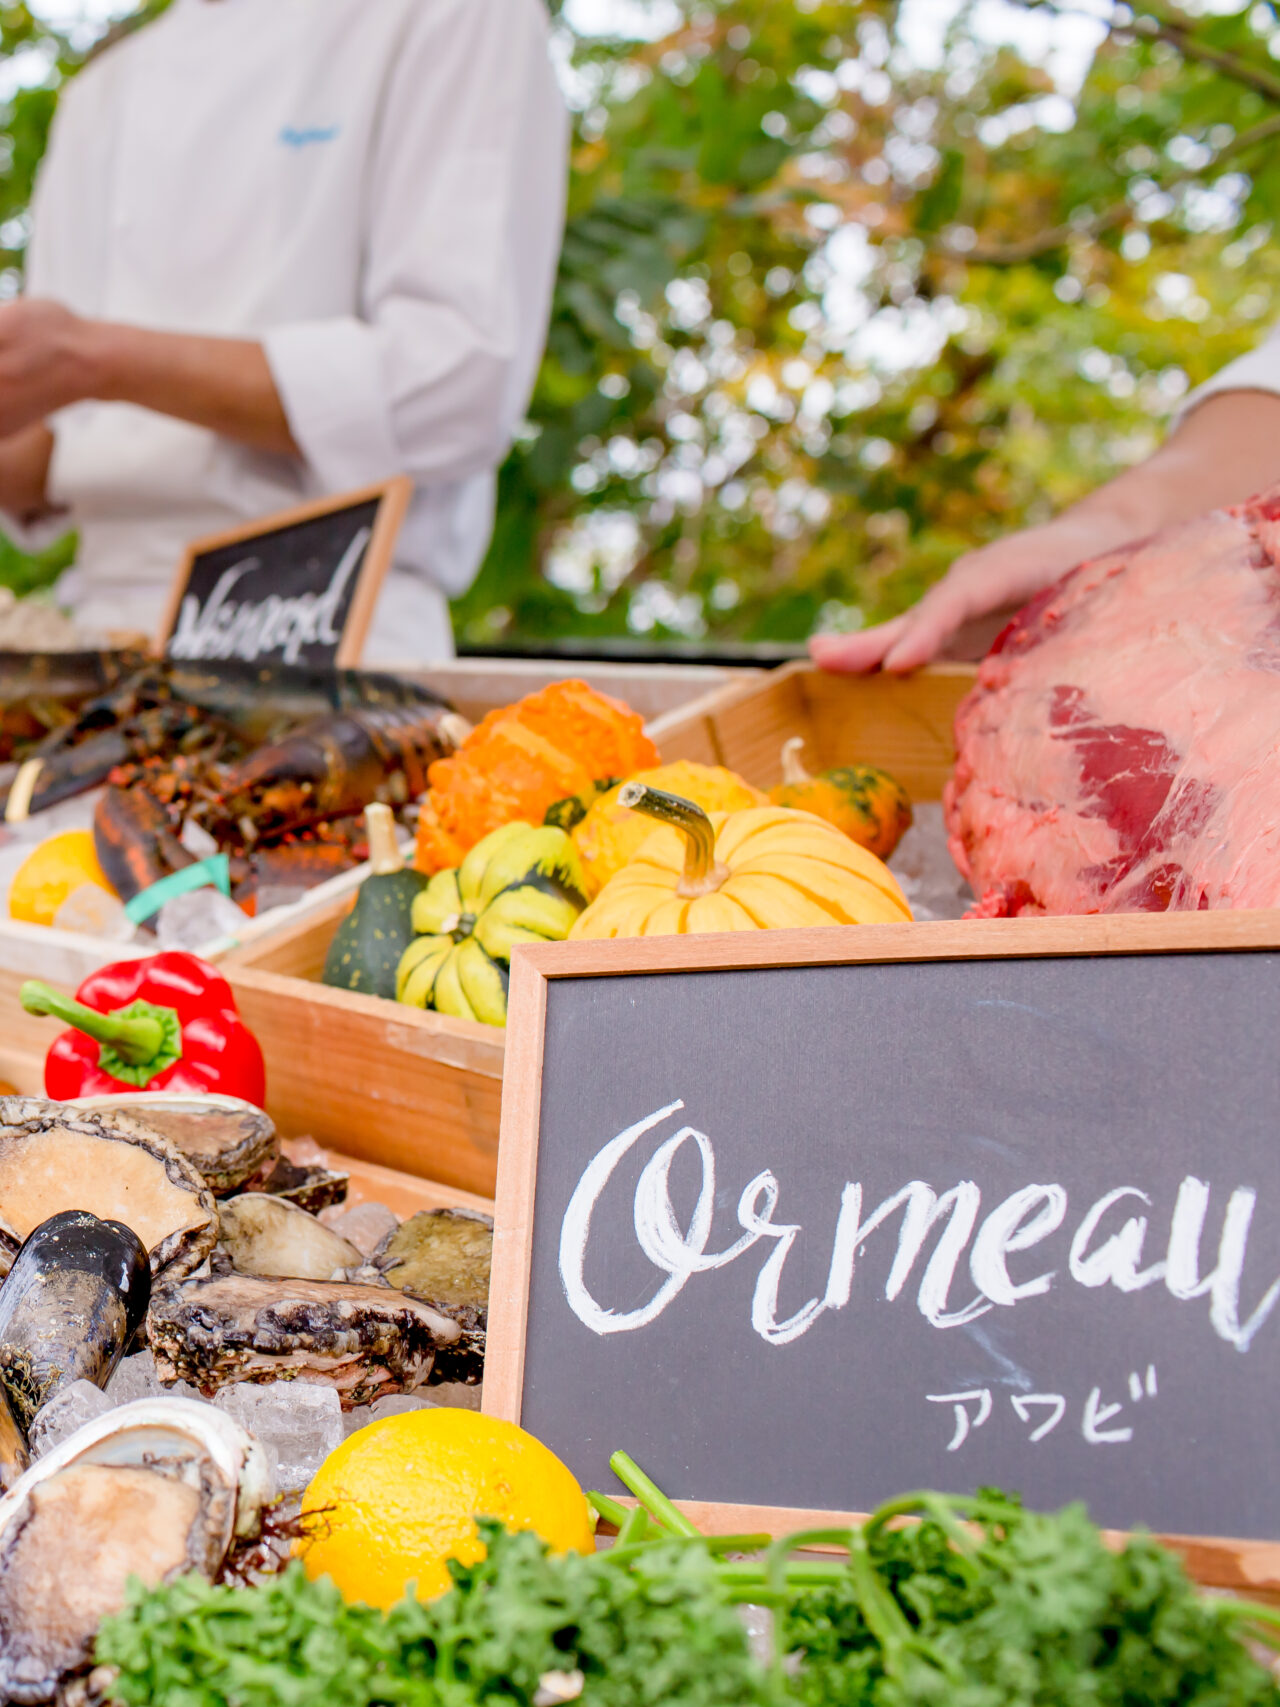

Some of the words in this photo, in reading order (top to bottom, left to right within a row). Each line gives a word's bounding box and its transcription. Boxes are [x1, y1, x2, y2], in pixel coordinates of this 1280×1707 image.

[558, 1098, 1280, 1352] Ormeau
[925, 1363, 1158, 1452] アワビ
